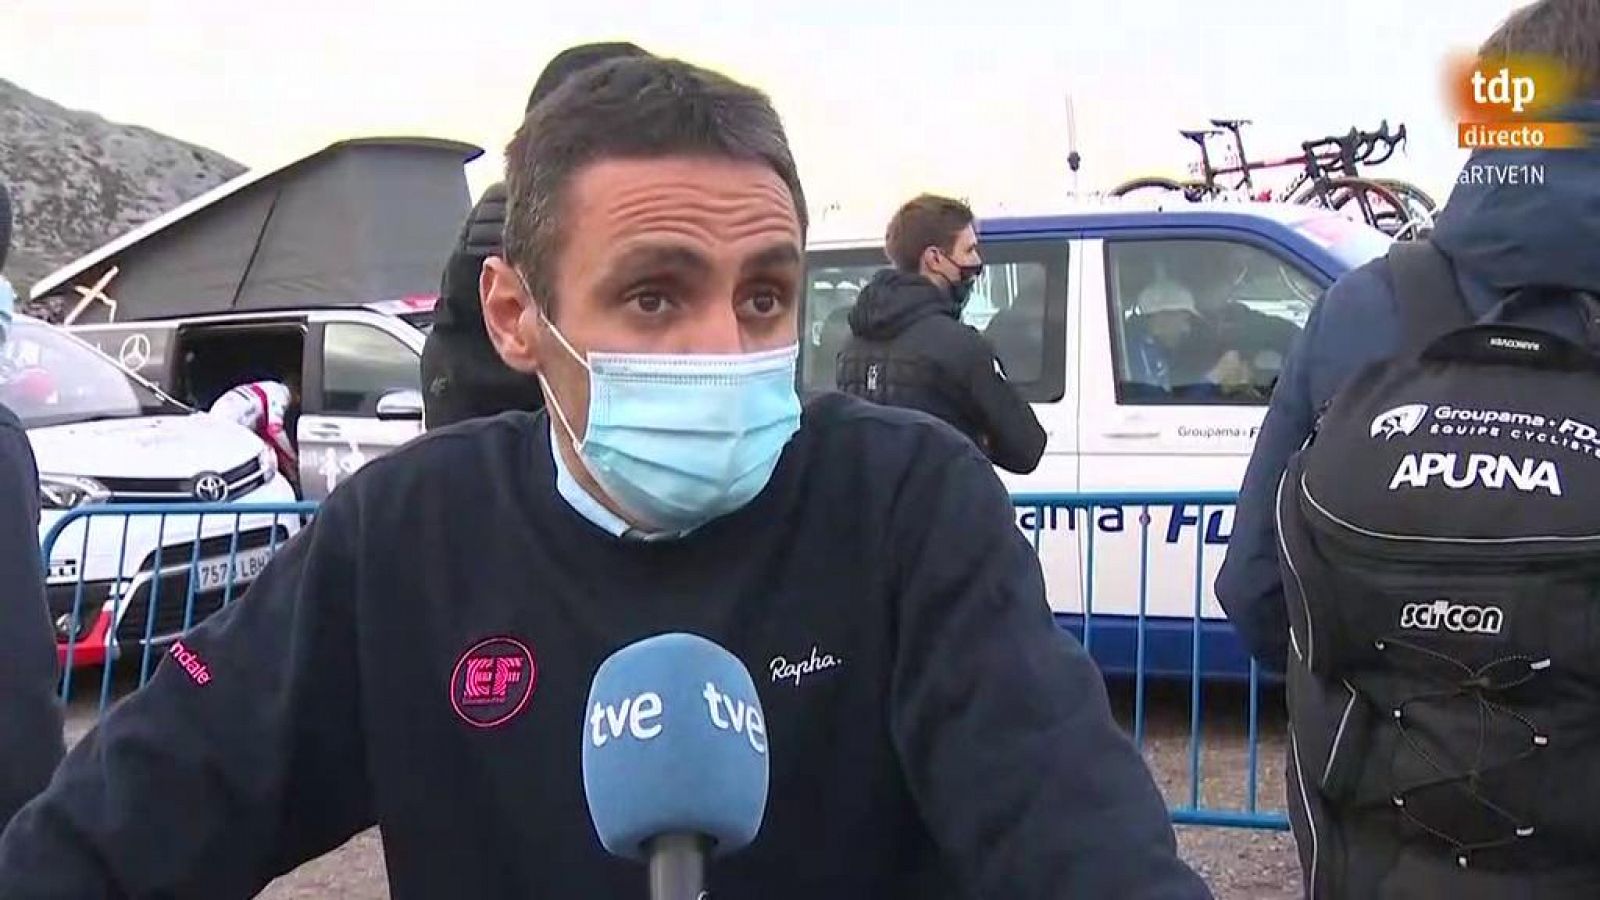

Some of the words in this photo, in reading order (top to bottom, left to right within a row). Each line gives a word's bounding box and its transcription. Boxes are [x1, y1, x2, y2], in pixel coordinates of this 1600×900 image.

[1178, 425, 1240, 439] Groupama
[1434, 405, 1545, 427] Groupama
[1388, 452, 1562, 496] APURNA
[201, 562, 237, 586] 757
[590, 690, 664, 748] tve
[703, 681, 766, 754] tve
